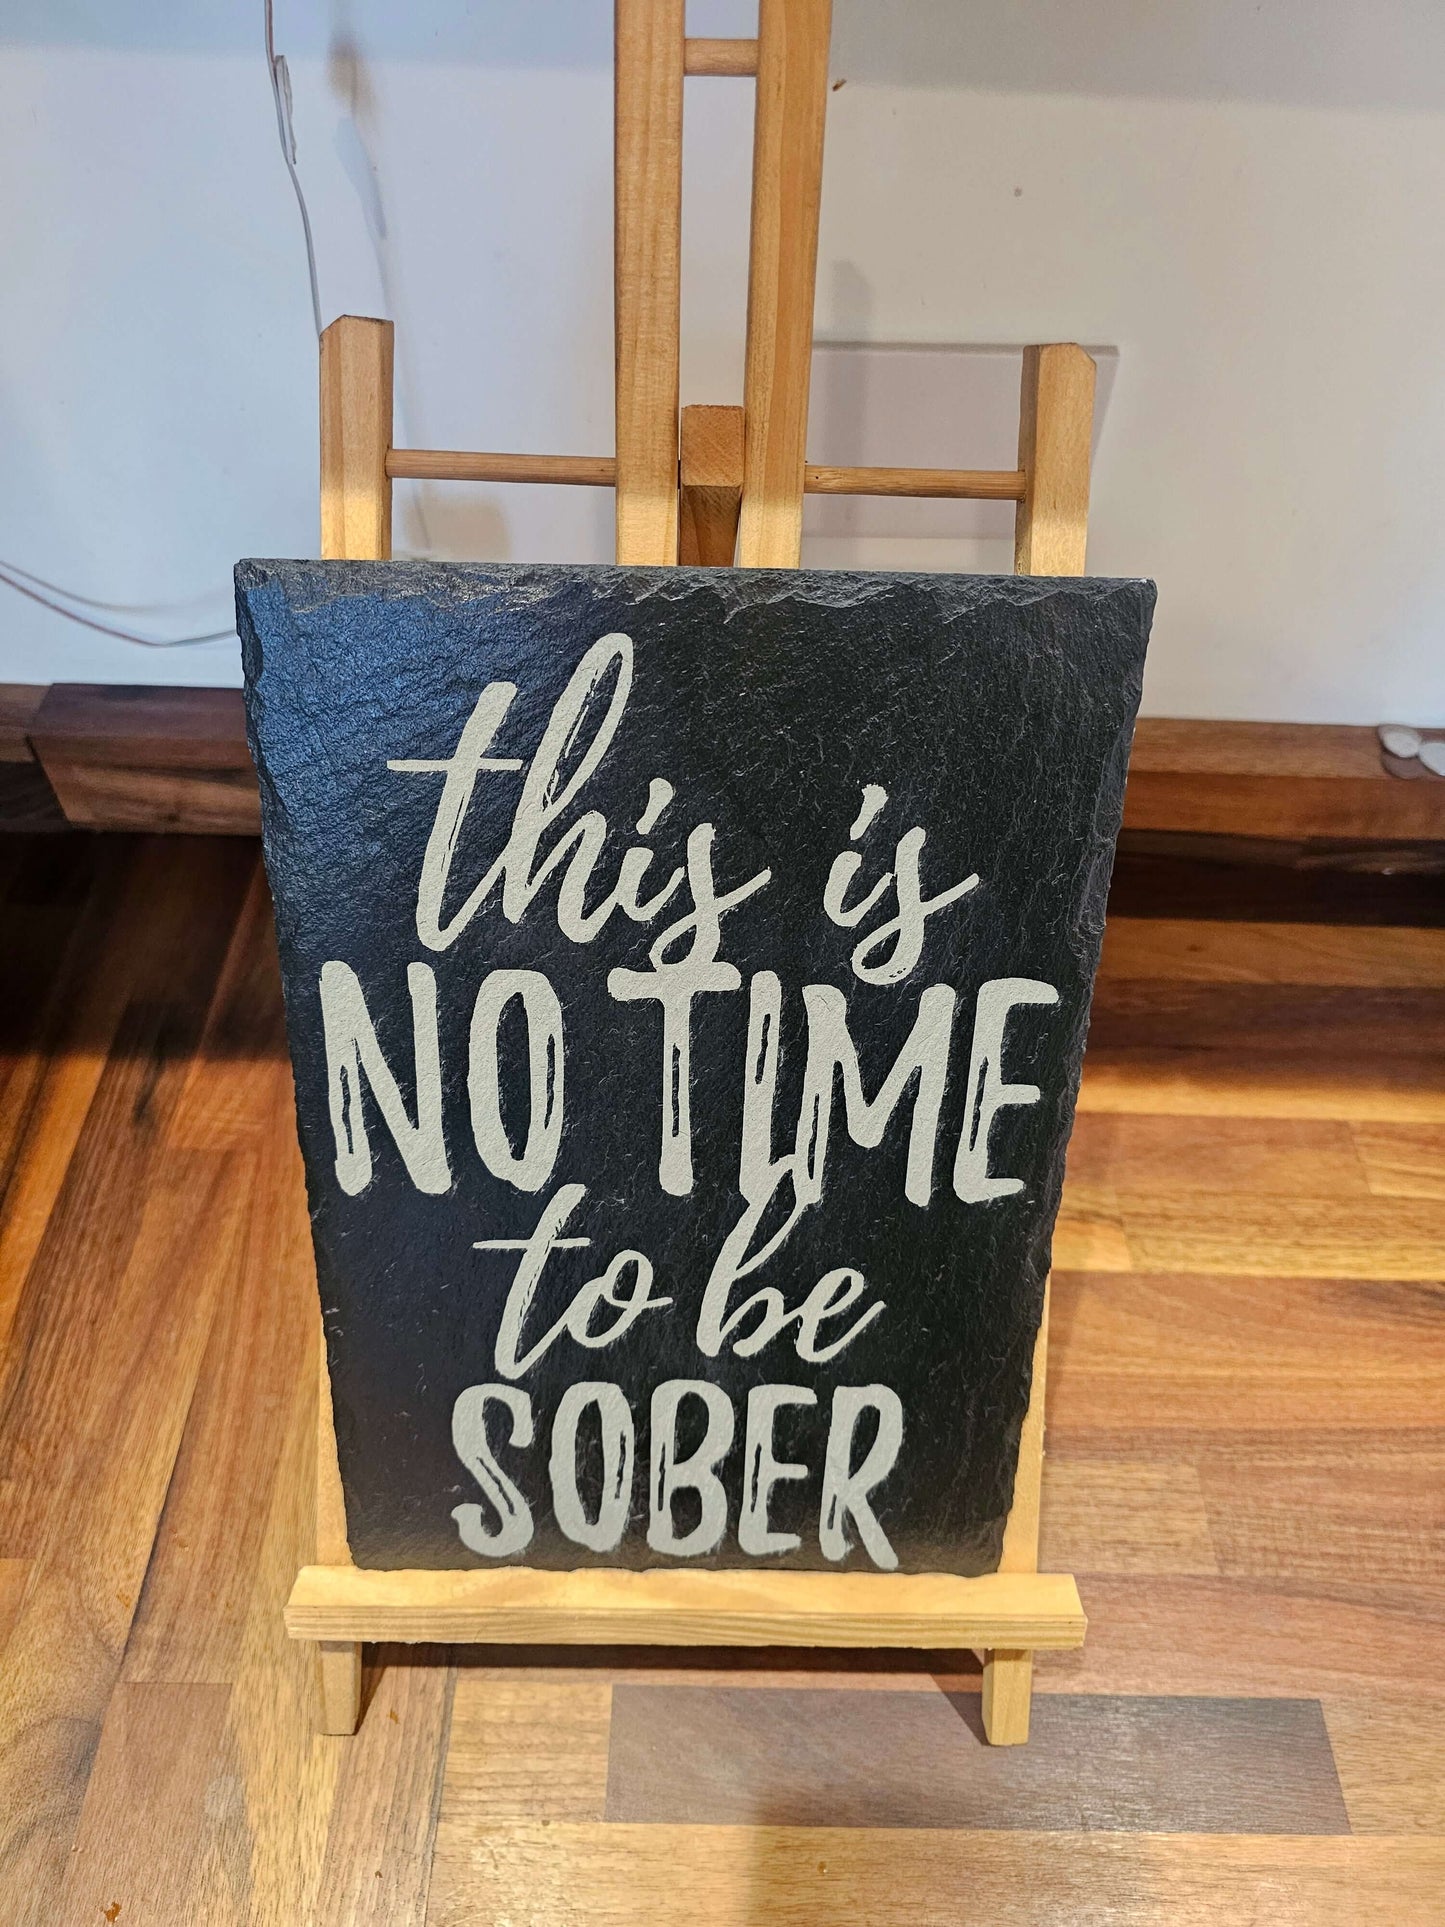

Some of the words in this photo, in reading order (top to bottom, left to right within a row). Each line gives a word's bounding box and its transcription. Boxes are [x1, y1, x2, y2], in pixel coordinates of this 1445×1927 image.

[388, 634, 771, 970] this
[825, 785, 980, 986] is
[320, 962, 566, 1197] NO
[608, 961, 1060, 1206] TIME
[474, 1185, 674, 1379] to
[697, 1154, 886, 1362] be
[452, 1381, 905, 1570] SOBER
